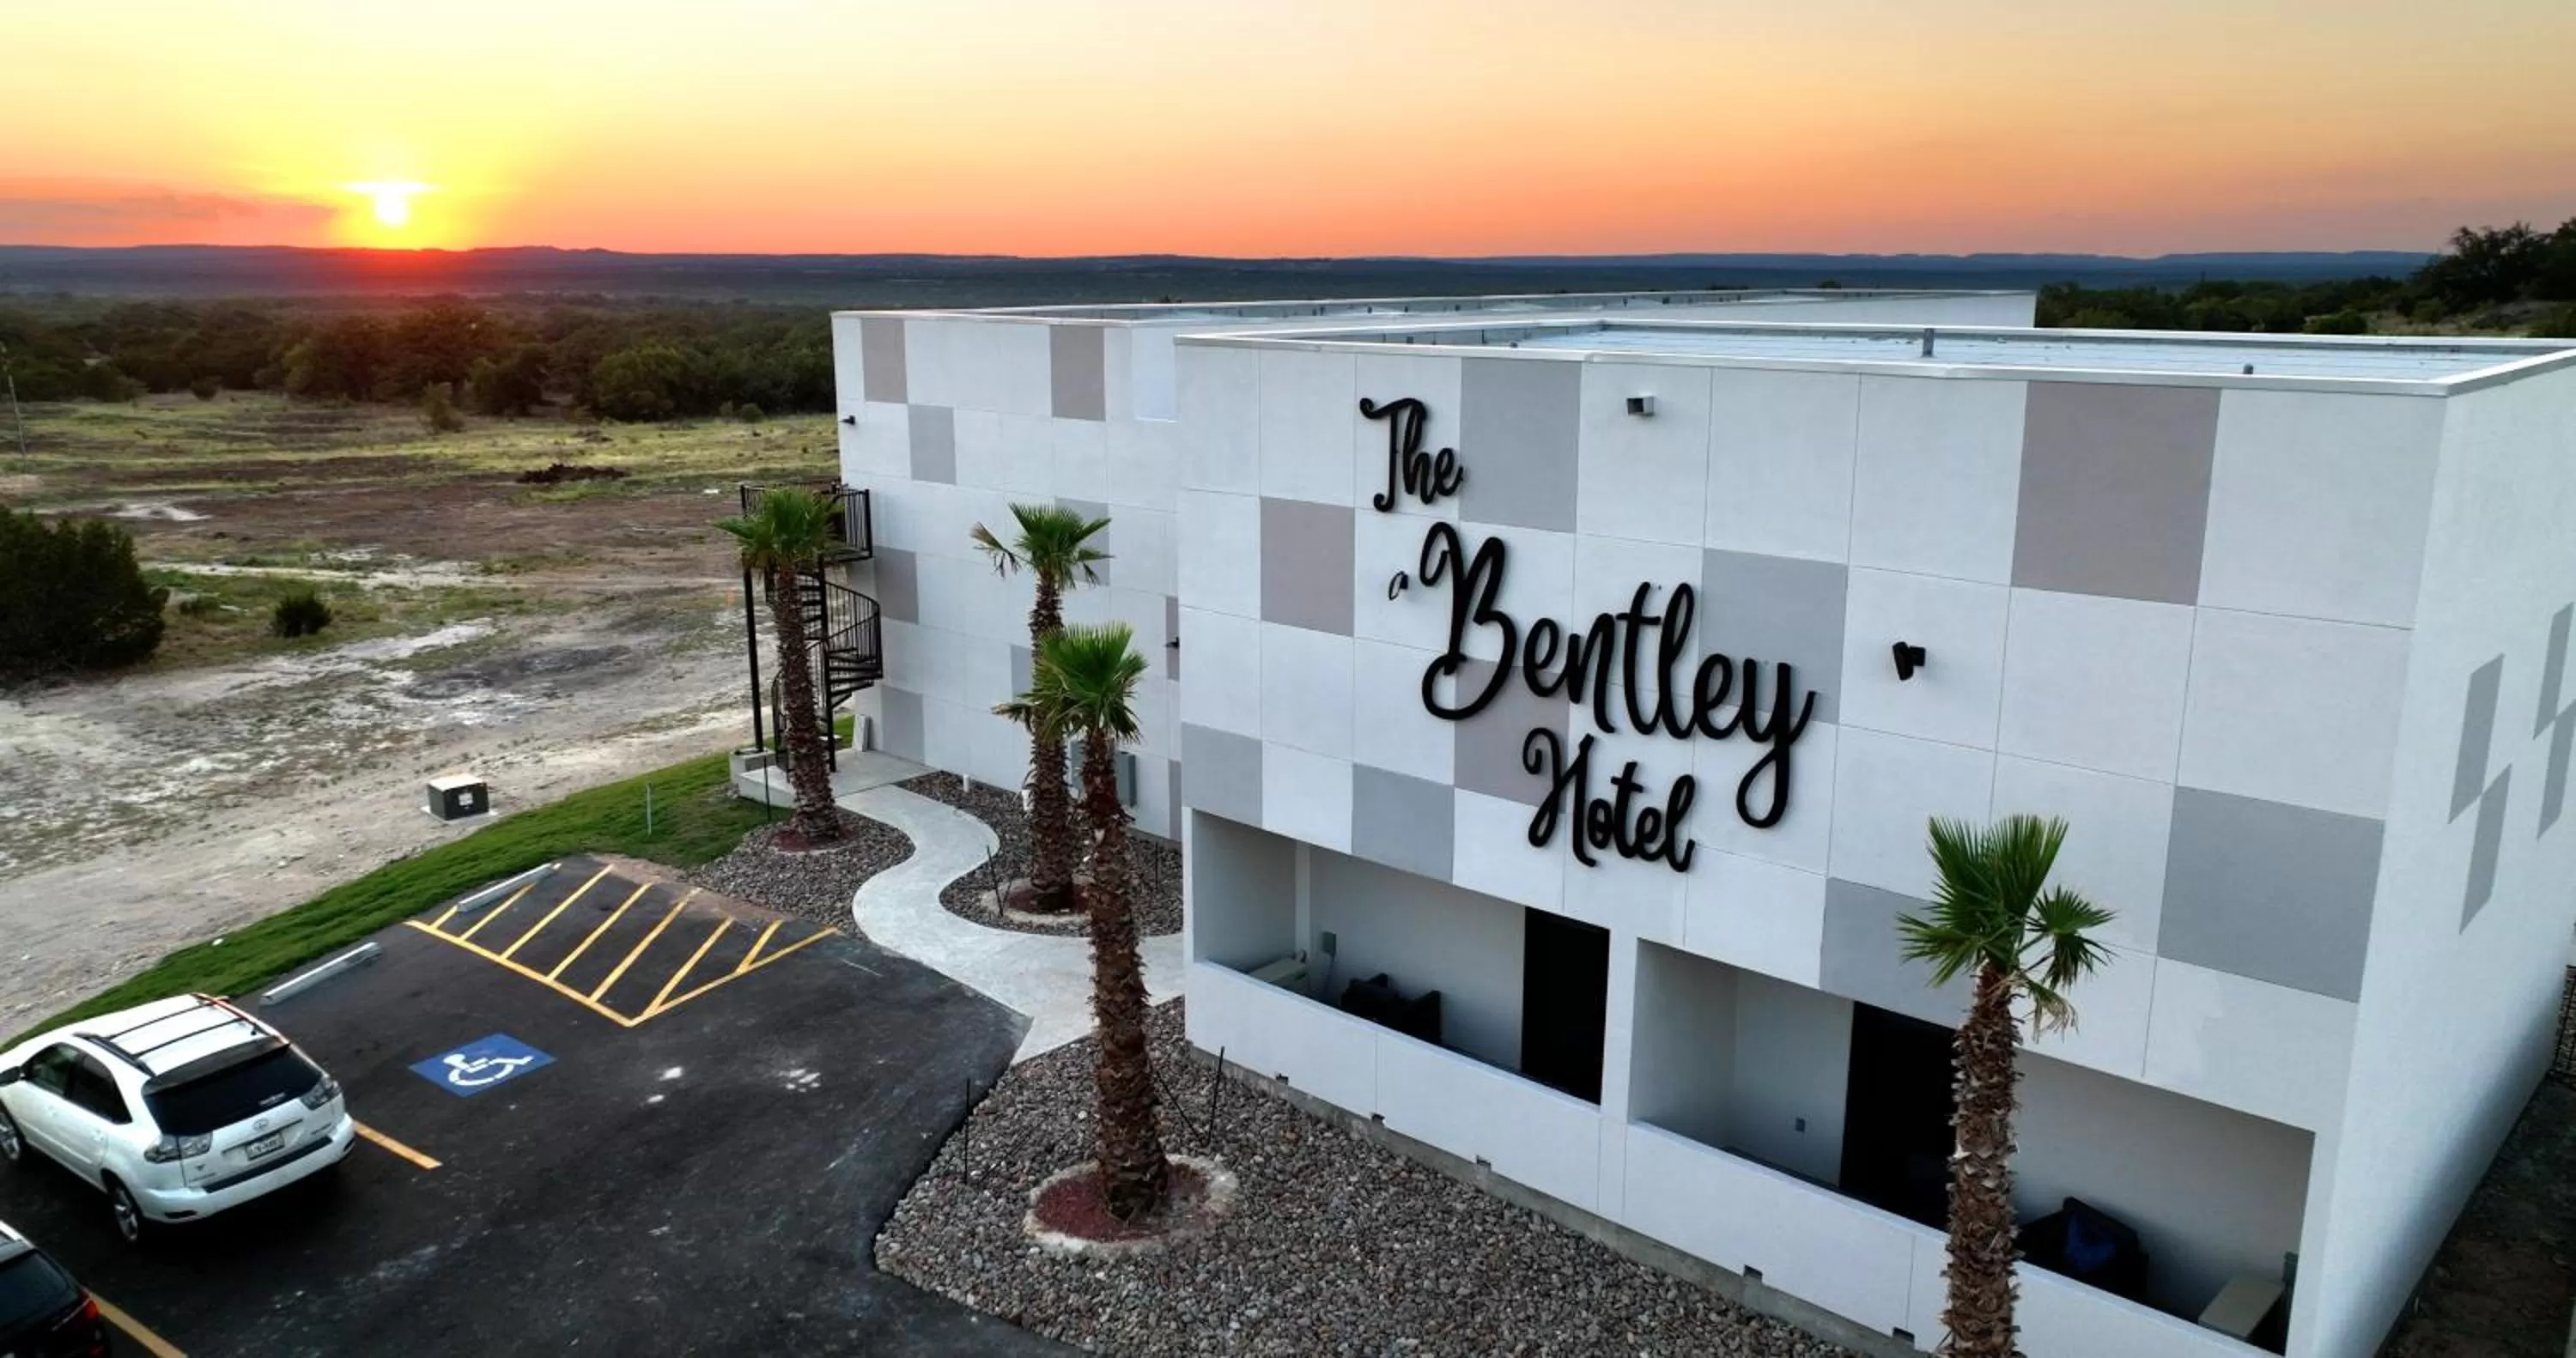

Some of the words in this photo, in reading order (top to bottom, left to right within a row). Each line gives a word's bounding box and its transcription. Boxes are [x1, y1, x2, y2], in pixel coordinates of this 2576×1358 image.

[1359, 397, 1465, 513] The
[1419, 521, 1818, 829] Bentley
[1522, 726, 1697, 873] Hotel
